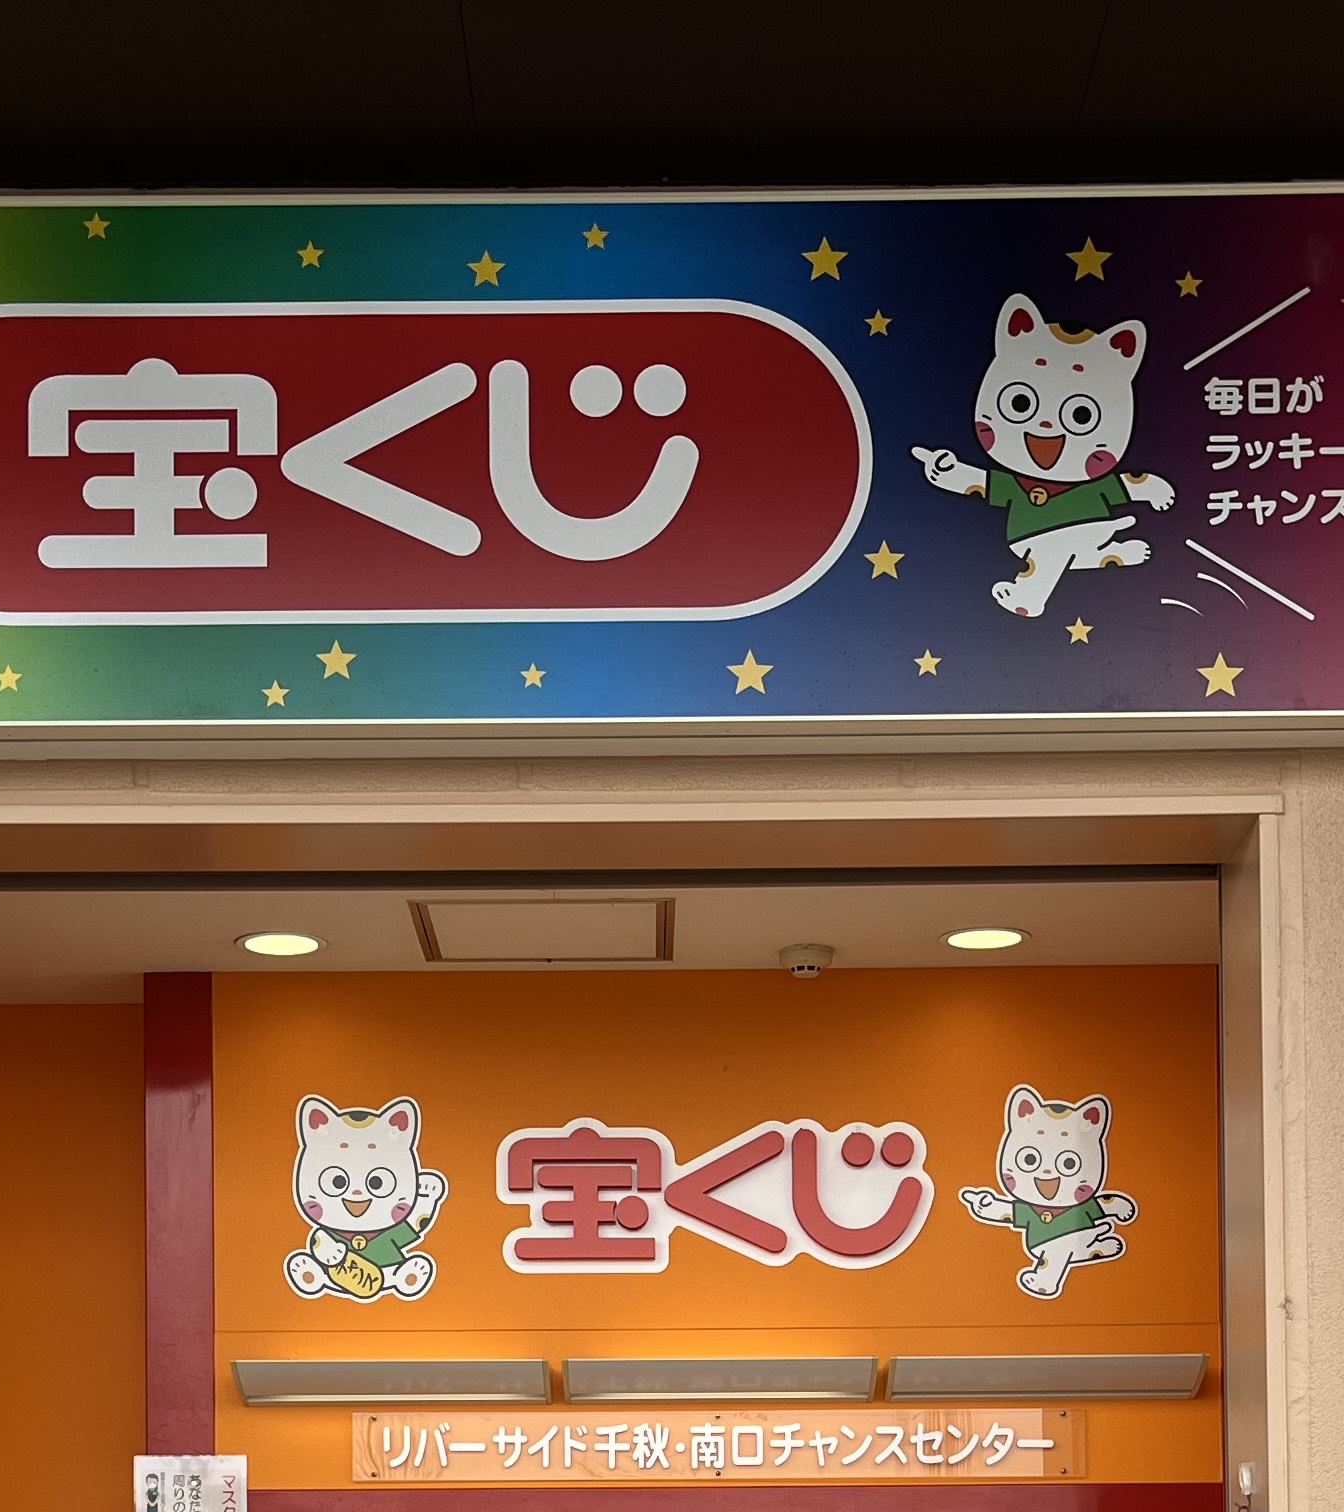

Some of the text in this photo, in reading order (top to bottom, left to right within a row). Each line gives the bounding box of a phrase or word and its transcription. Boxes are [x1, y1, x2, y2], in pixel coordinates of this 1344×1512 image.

[1203, 376, 1325, 416] 毎日が
[27, 357, 700, 569] 宝くじ
[508, 1125, 923, 1265] 宝くじ
[382, 1420, 1055, 1470] リバーサイド千秋・南口チャンスセンター
